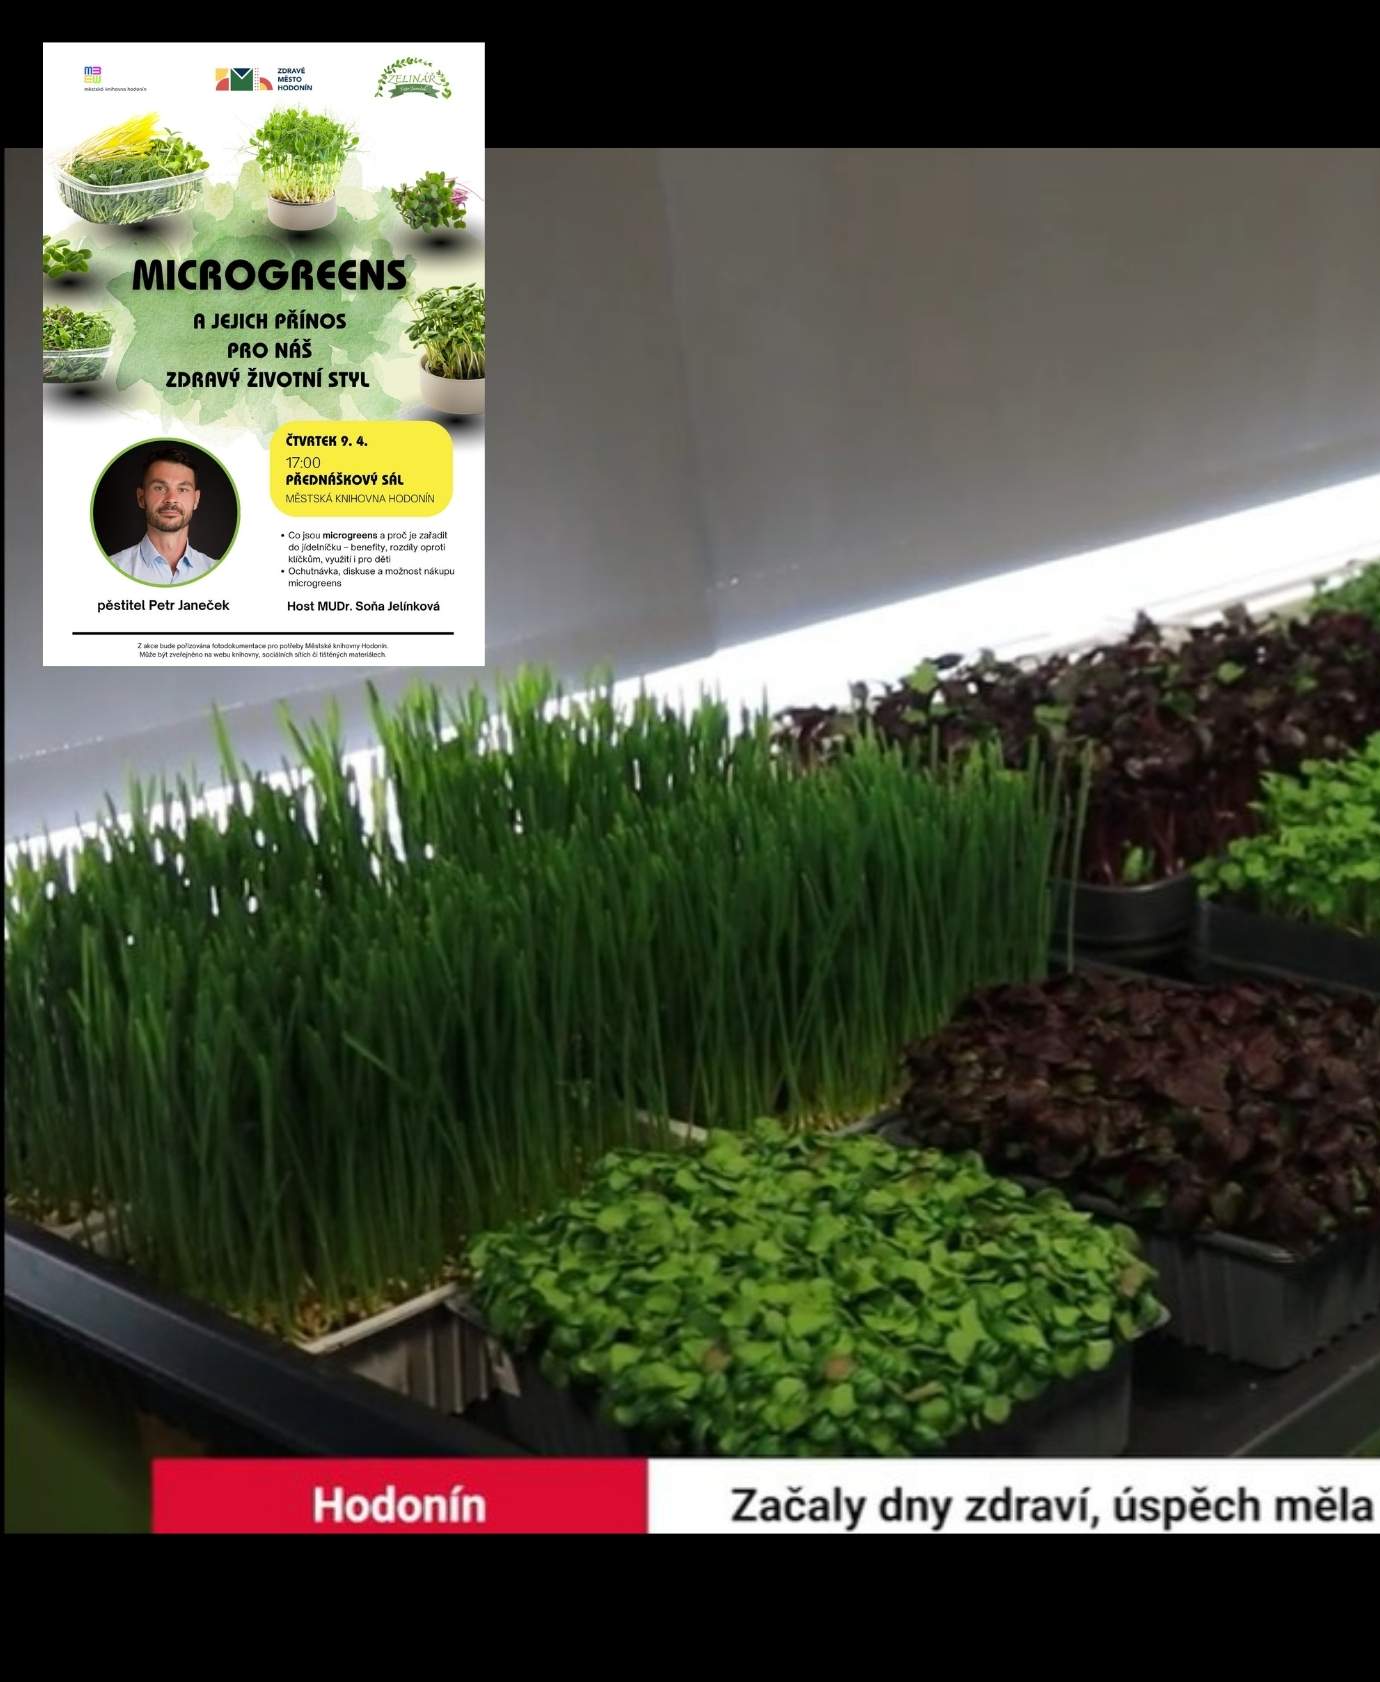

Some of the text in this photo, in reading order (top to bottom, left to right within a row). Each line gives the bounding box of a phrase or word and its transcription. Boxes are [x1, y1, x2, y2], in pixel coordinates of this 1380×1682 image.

[277, 75, 303, 83] MĚSTO
[277, 83, 313, 91] HODONÍN
[133, 259, 406, 290] MICROGREENS
[194, 310, 346, 329] A JEJICH PŘÍNOS
[228, 339, 312, 358] PRO NÁŠ
[166, 368, 369, 387] ZDRAVÝ ŽIVOTNÍ STYL
[286, 433, 367, 446] ČTVRTEK 9. 4.
[286, 457, 320, 468] 17:00
[286, 472, 403, 485] PŘEDNÁŠKOVÝ SÁL
[286, 492, 434, 503] MĚSTSKÁ KNIHOVNA HODONÍN
[288, 531, 301, 540] Co
[302, 531, 321, 542] jsou
[323, 531, 378, 541] microgreens
[388, 531, 408, 542] proč
[408, 532, 418, 542] je
[419, 531, 448, 540] zařadit
[288, 544, 300, 552] do
[301, 543, 342, 553] jídelníčku
[351, 543, 388, 553] benefity,
[390, 543, 419, 553] rozdíly
[421, 544, 446, 553] oproti
[289, 555, 324, 564] klíčkům,
[325, 555, 352, 565] využití
[358, 557, 373, 565] pro
[375, 555, 391, 564] děti
[288, 567, 341, 577] Ochutnávka,
[343, 567, 376, 576] diskuse
[385, 567, 423, 576] možnost
[424, 567, 455, 577] nákupu
[289, 579, 342, 589] microgreens
[98, 600, 231, 613] pěstitel Petr Janeček
[288, 601, 441, 612] Host MUDr. Soňa Jelínková
